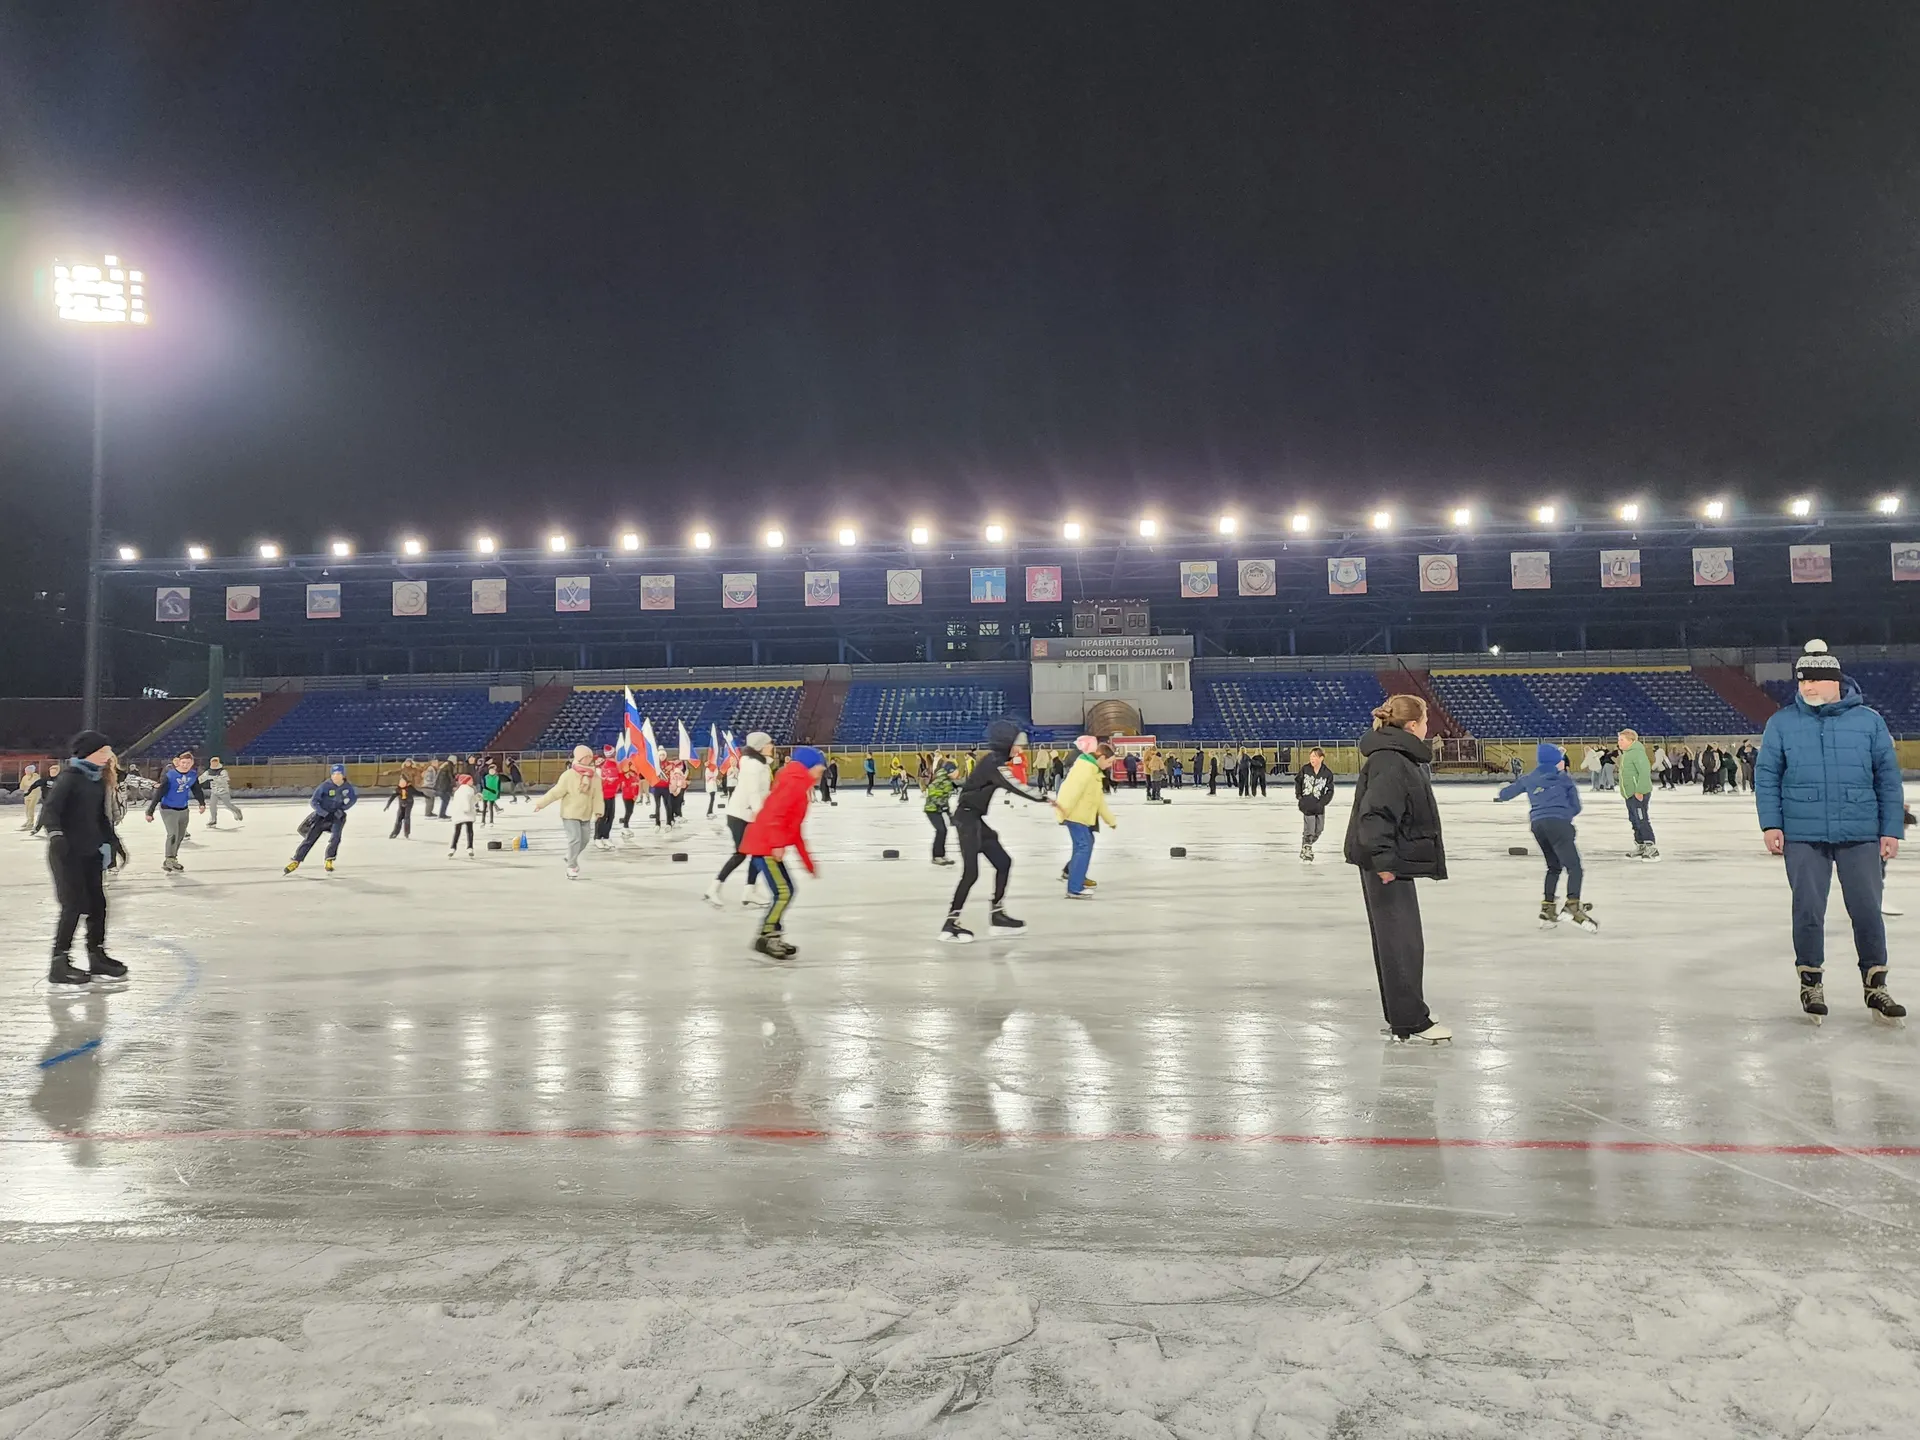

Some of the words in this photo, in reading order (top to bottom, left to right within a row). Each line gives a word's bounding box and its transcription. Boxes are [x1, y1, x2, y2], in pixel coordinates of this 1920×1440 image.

[1080, 638, 1159, 647] ПРАВИТЕЛЬСТВО
[1065, 649, 1129, 657] МОСКОВСКОЙ
[1131, 648, 1175, 656] ОБЛАСТИ
